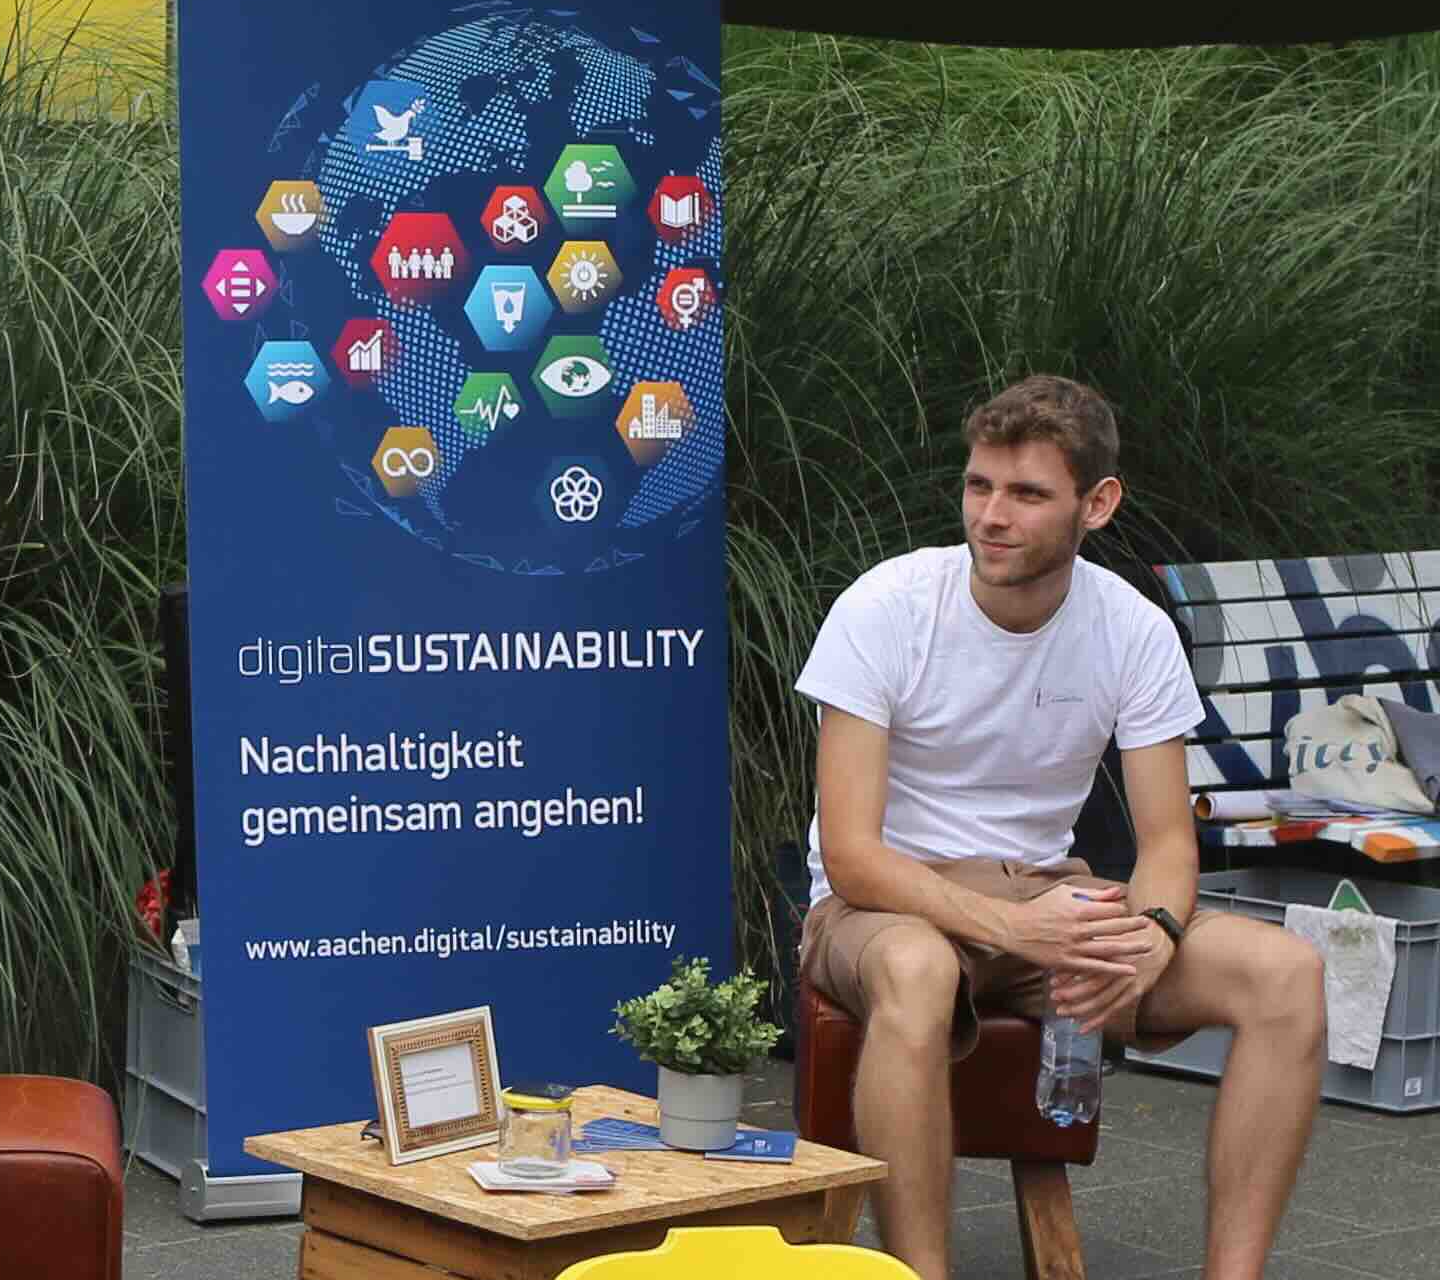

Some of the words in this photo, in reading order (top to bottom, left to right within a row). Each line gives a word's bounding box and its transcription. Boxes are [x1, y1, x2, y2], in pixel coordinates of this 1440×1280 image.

[237, 628, 705, 684] digitalSUSTAINABILITY
[239, 730, 525, 780] Nachhaltigkeit
[241, 794, 463, 846] gemeinsam
[473, 786, 645, 837] angehen!
[245, 919, 677, 960] www.aachen.digital/sustainability
